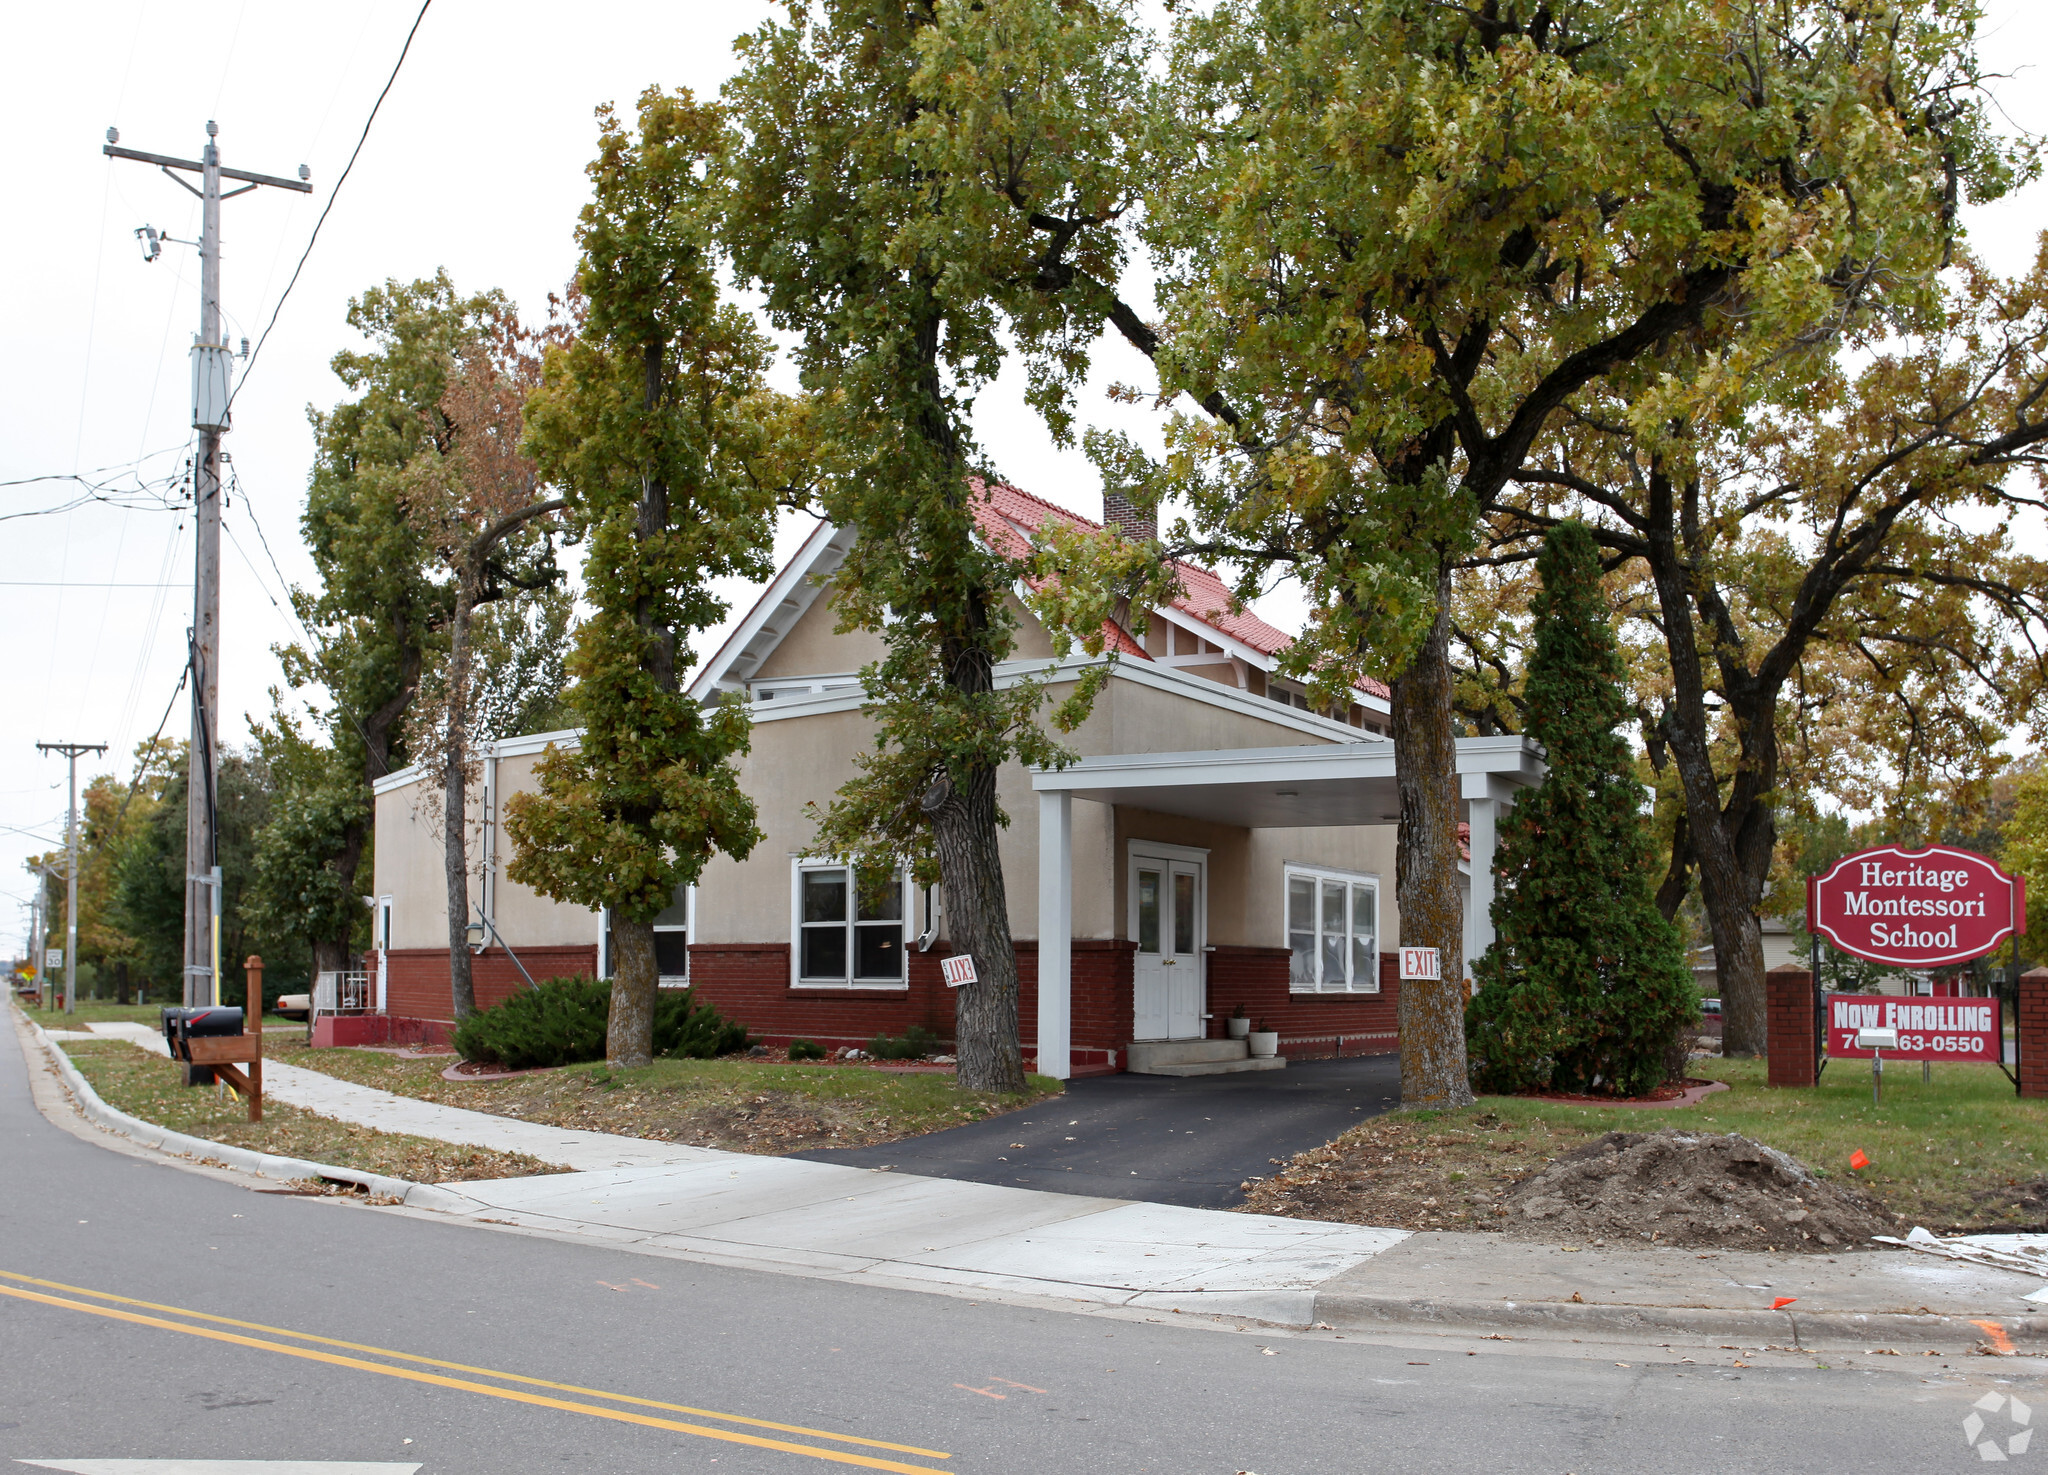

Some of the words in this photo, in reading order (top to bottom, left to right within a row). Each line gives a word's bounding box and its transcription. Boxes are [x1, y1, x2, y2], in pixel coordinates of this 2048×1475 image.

[1860, 862, 1968, 892] Heritage
[1843, 891, 1986, 917] Montessori
[1870, 922, 1958, 948] School
[48, 958, 61, 966] 30
[948, 957, 975, 983] EXIT
[1405, 950, 1435, 976] EXIT
[1885, 1002, 1992, 1032] ENROLLING
